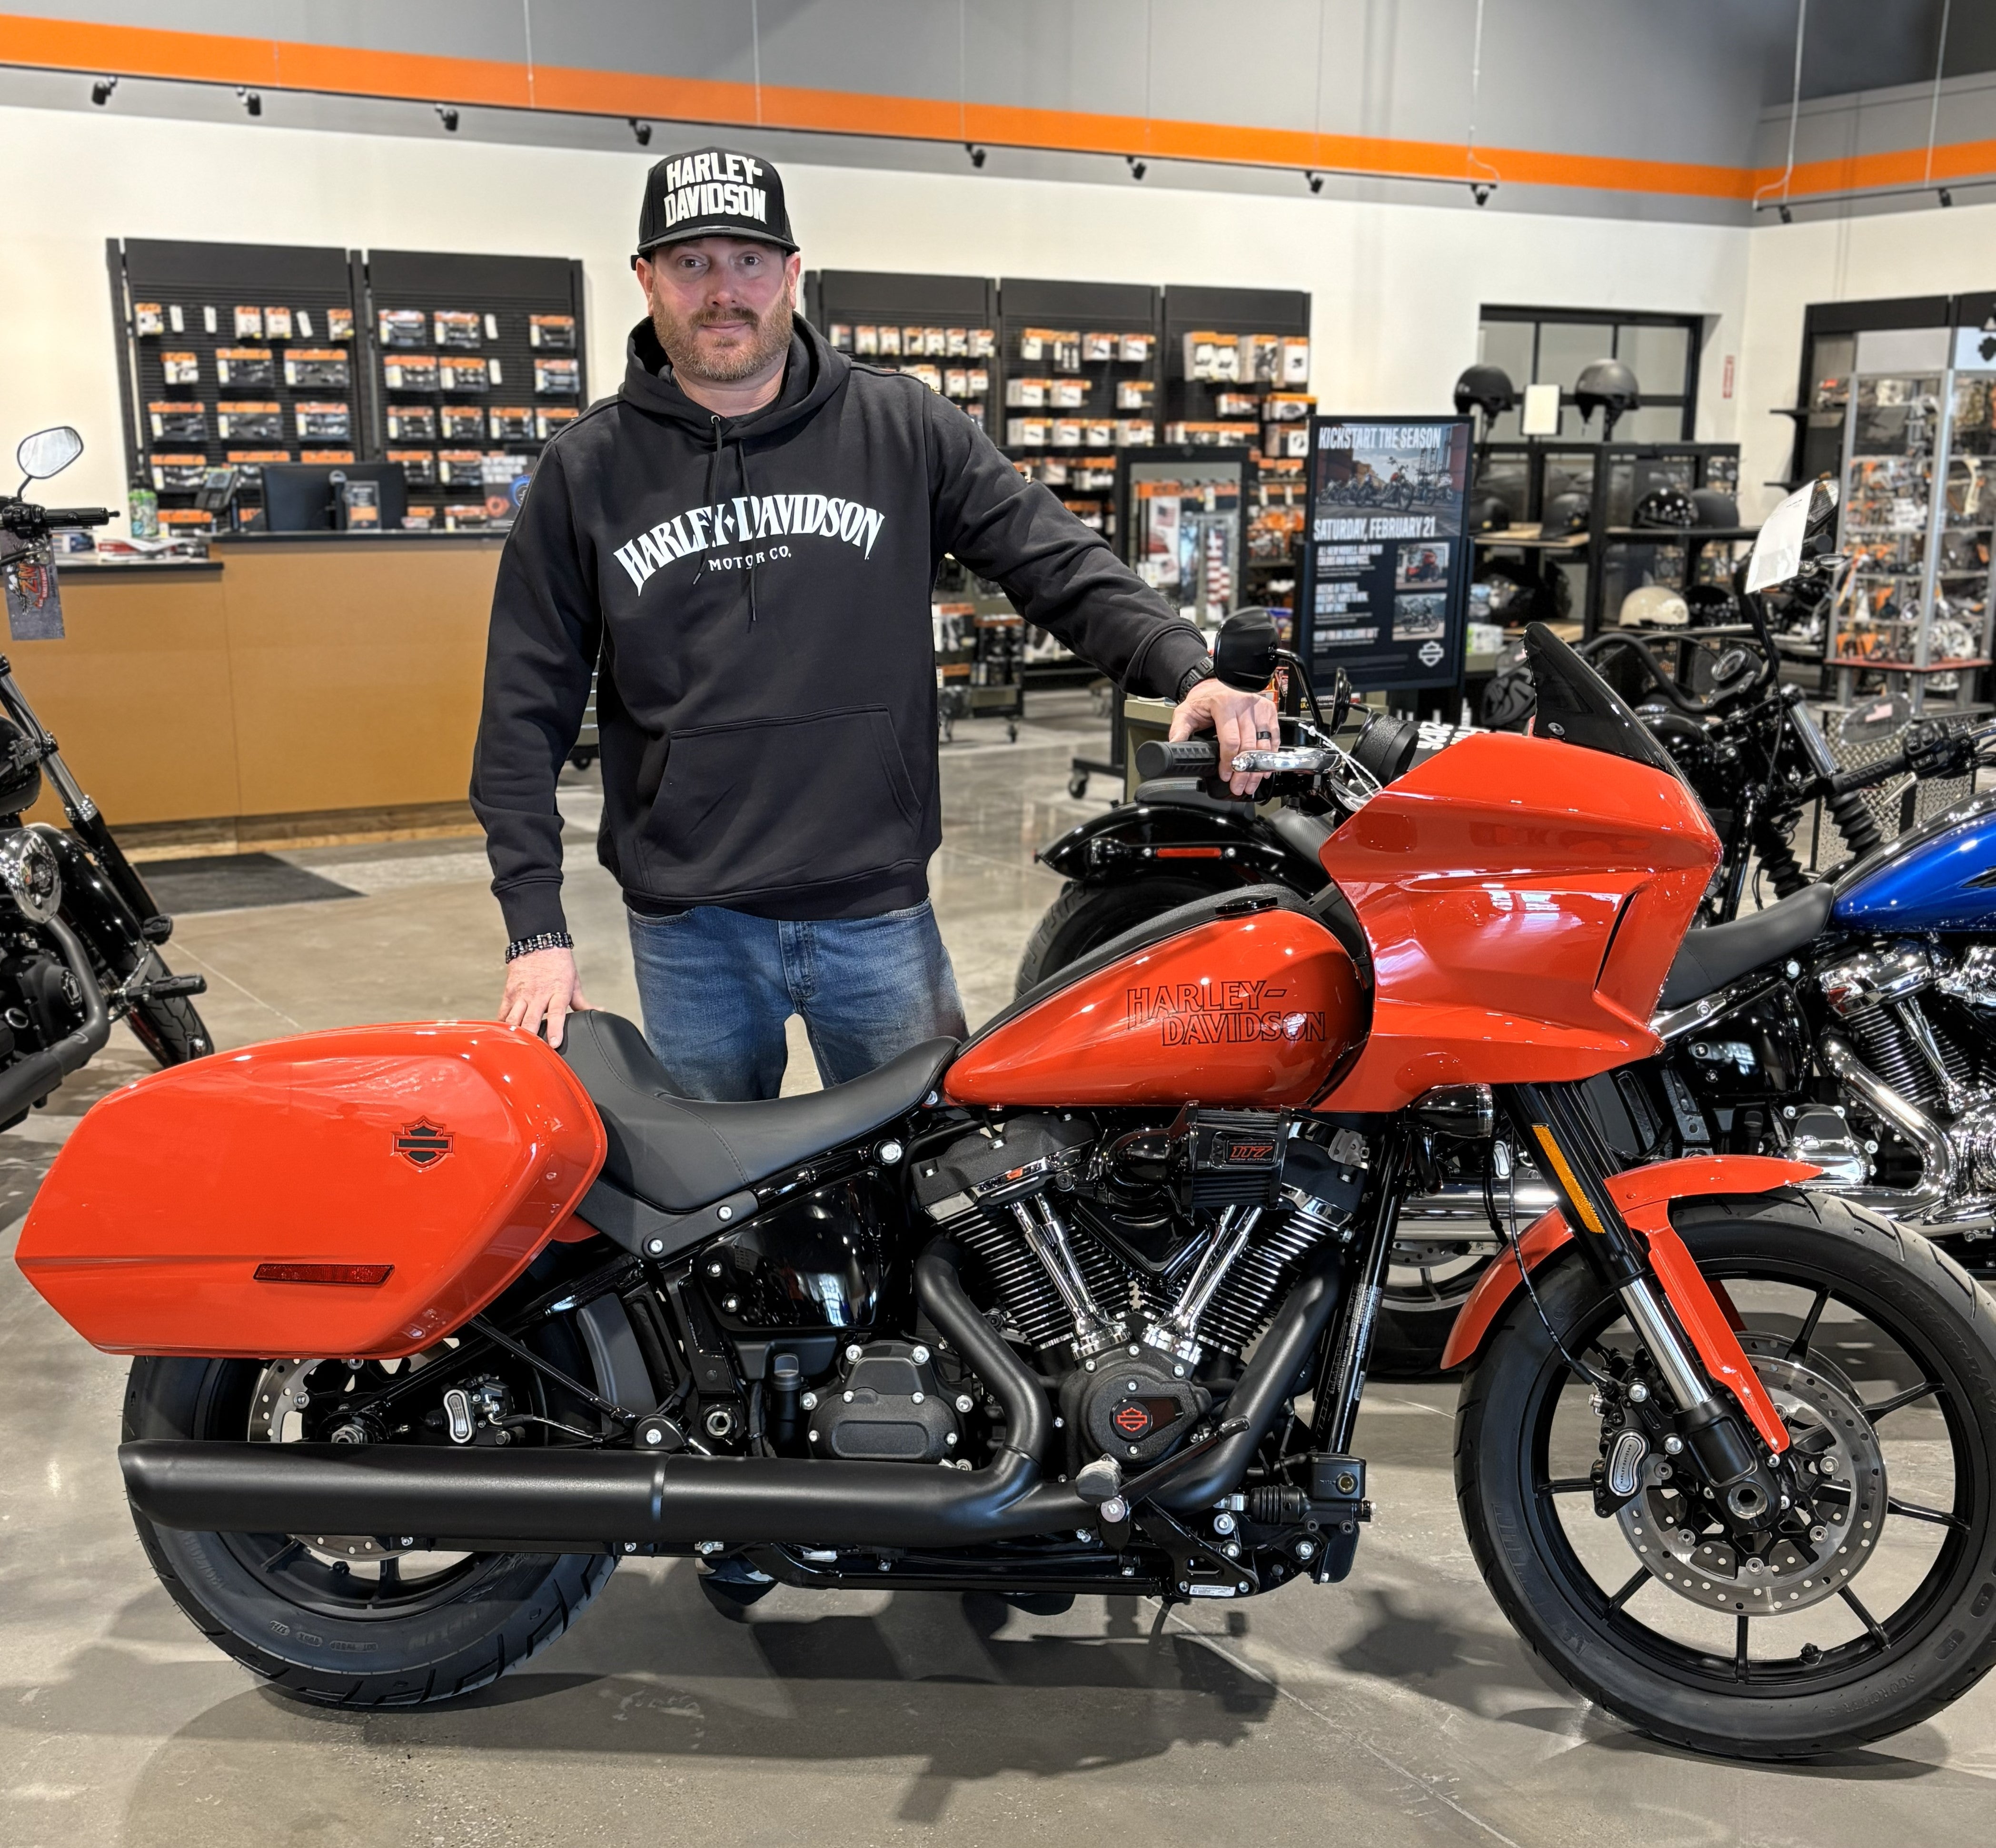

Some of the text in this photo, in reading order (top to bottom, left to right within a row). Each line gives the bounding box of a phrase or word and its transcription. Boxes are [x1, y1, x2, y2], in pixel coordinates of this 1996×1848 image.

[666, 152, 763, 192] HARLEY-
[664, 182, 767, 228] DAVIDSON
[1318, 427, 1441, 449] KICKSTART THE SEASON
[1313, 515, 1436, 542] SATURDAY, FEBRUARY 21
[708, 552, 765, 571] MOTOR
[1127, 979, 1288, 1031] HARLEY-
[1162, 1011, 1326, 1047] DAVIDSON
[1230, 1146, 1273, 1158] 117
